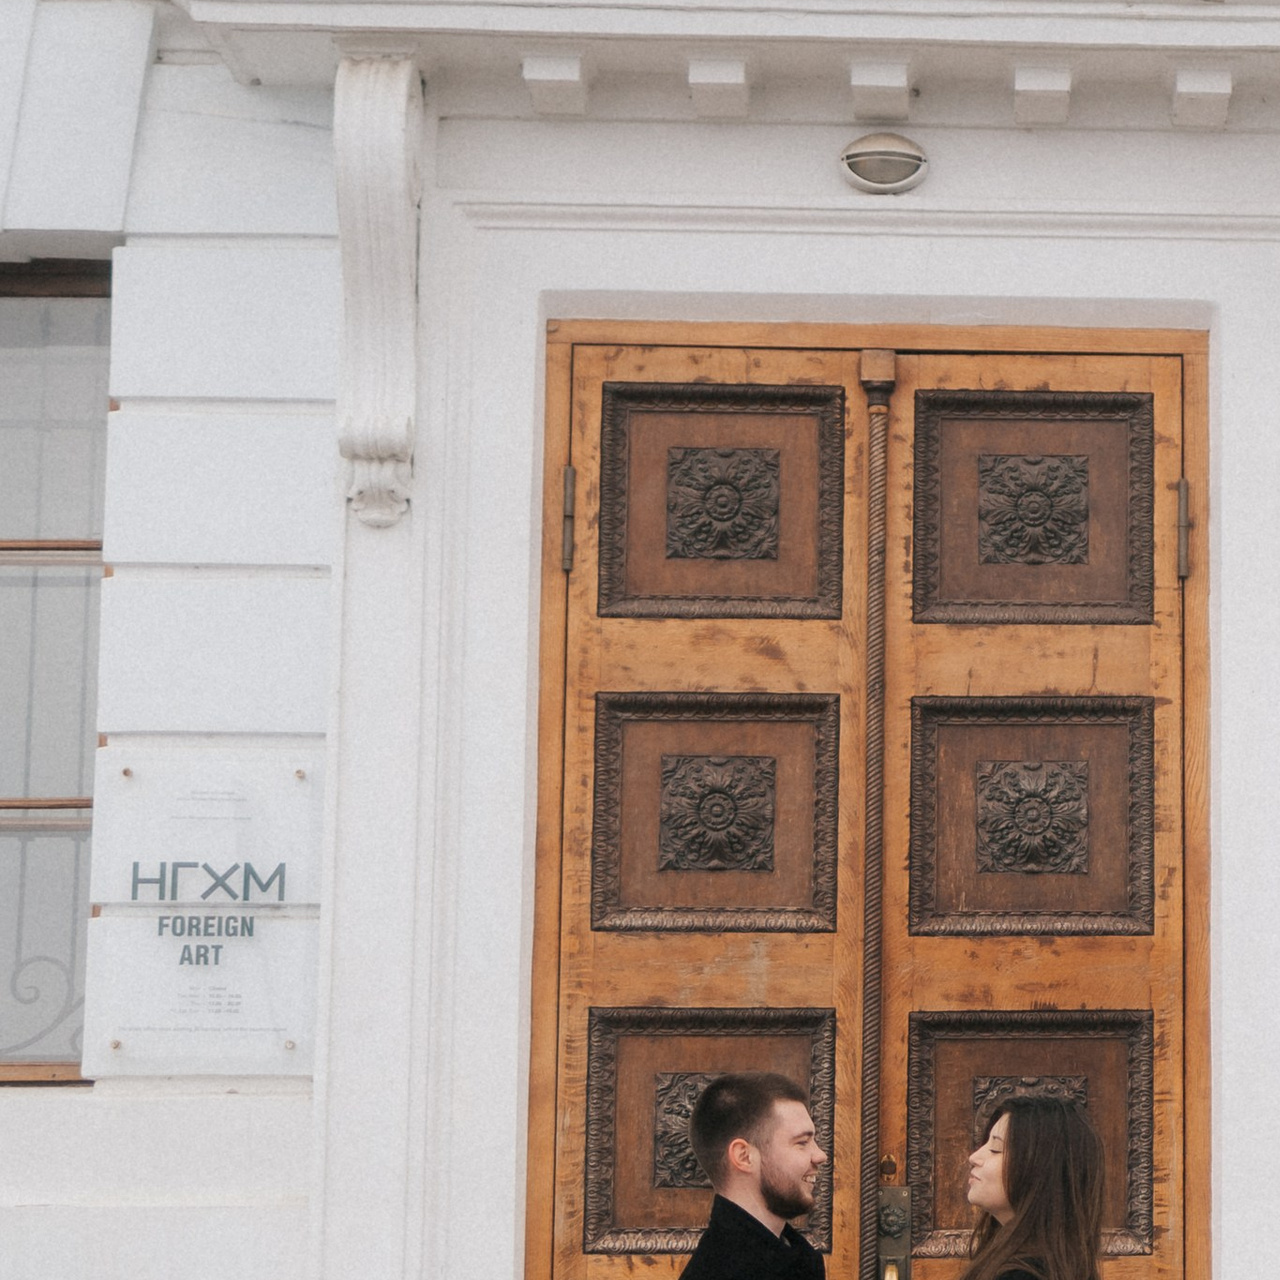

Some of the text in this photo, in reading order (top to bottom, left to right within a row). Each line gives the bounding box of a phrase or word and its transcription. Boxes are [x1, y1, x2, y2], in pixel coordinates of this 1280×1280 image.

[131, 861, 286, 902] НГХМ
[157, 914, 256, 938] FOREIGN
[178, 943, 224, 967] ART
